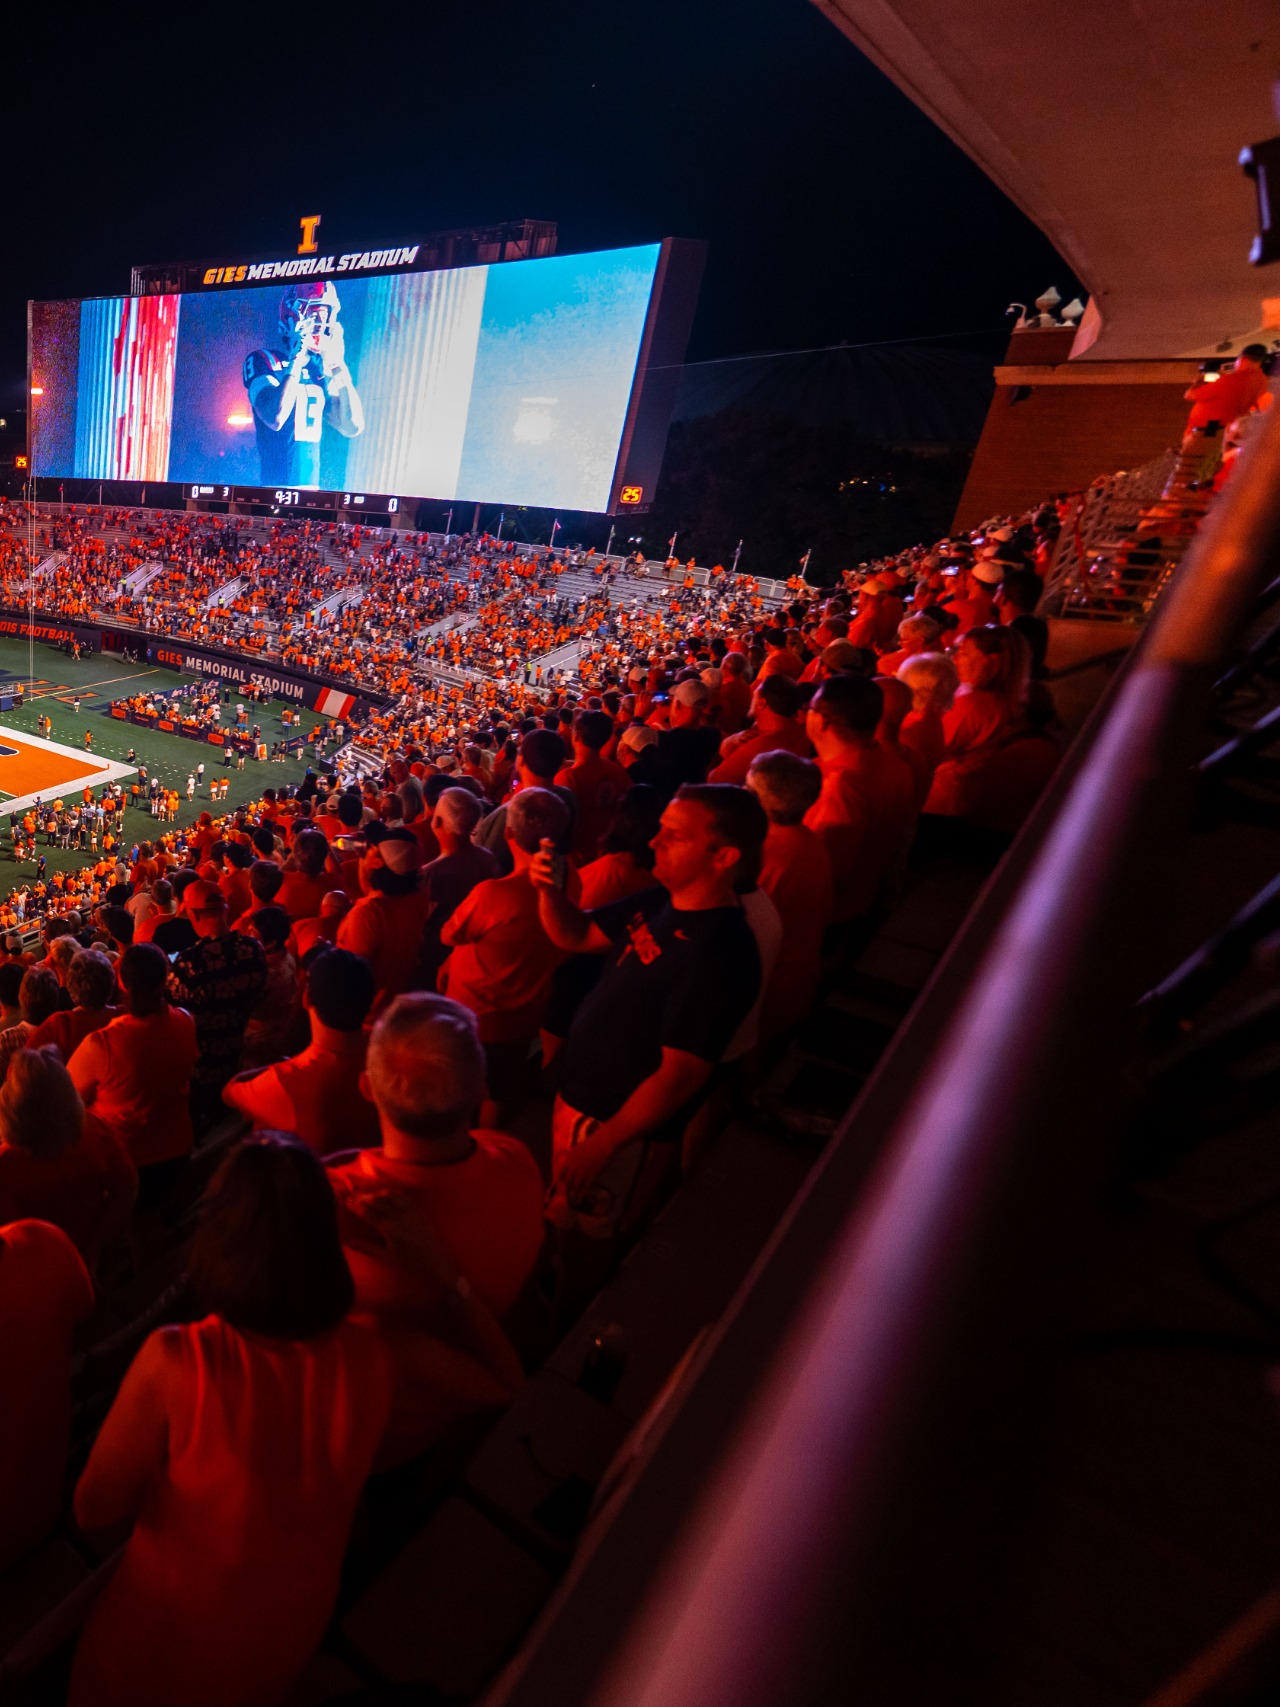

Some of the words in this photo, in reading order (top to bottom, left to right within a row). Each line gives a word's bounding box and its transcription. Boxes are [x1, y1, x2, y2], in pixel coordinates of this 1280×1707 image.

[203, 265, 248, 284] GIES
[247, 255, 335, 280] MEMORIAL
[336, 246, 420, 271] STADIUM
[274, 490, 300, 504] 9:37
[622, 488, 640, 501] 25
[19, 624, 76, 643] FOOTBALL
[156, 649, 183, 666] GIES
[186, 655, 247, 684] MEMORIAL
[249, 672, 305, 700] STADIUM
